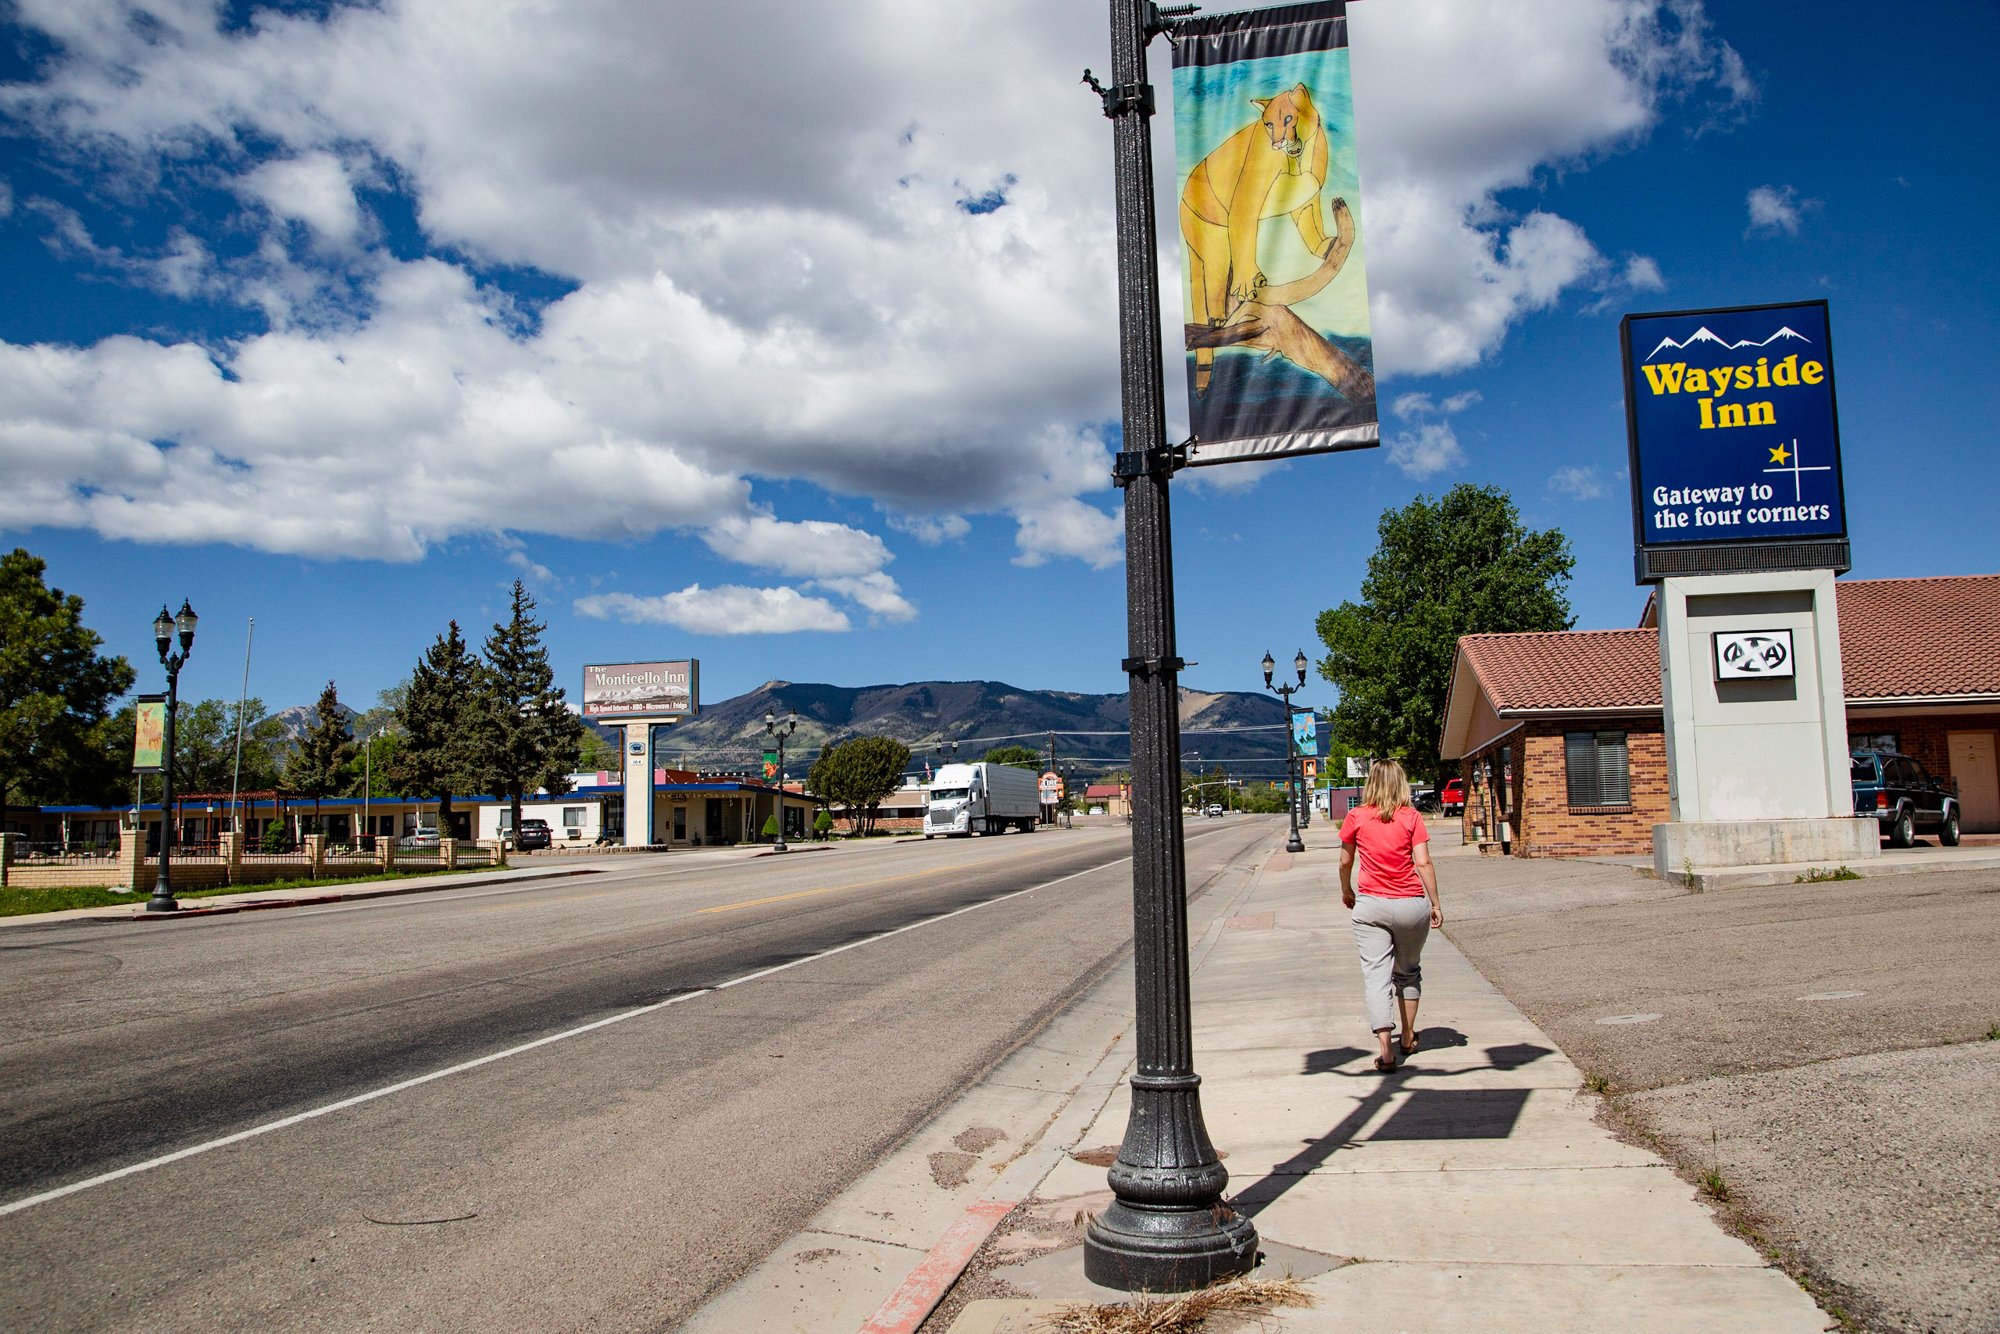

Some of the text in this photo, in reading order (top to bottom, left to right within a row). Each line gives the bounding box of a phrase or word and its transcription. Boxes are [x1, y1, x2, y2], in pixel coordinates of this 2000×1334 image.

[1641, 354, 1824, 398] Wayside
[1699, 398, 1776, 429] Inn
[1653, 483, 1773, 507] Gateway to
[1655, 504, 1831, 529] the four corners
[595, 670, 685, 686] Monticello Inn
[589, 705, 599, 714] High
[600, 704, 612, 713] Speed
[613, 704, 630, 712] Internet
[632, 703, 643, 711] HBO
[646, 702, 669, 710] Microwave
[673, 701, 687, 710] Fridge
